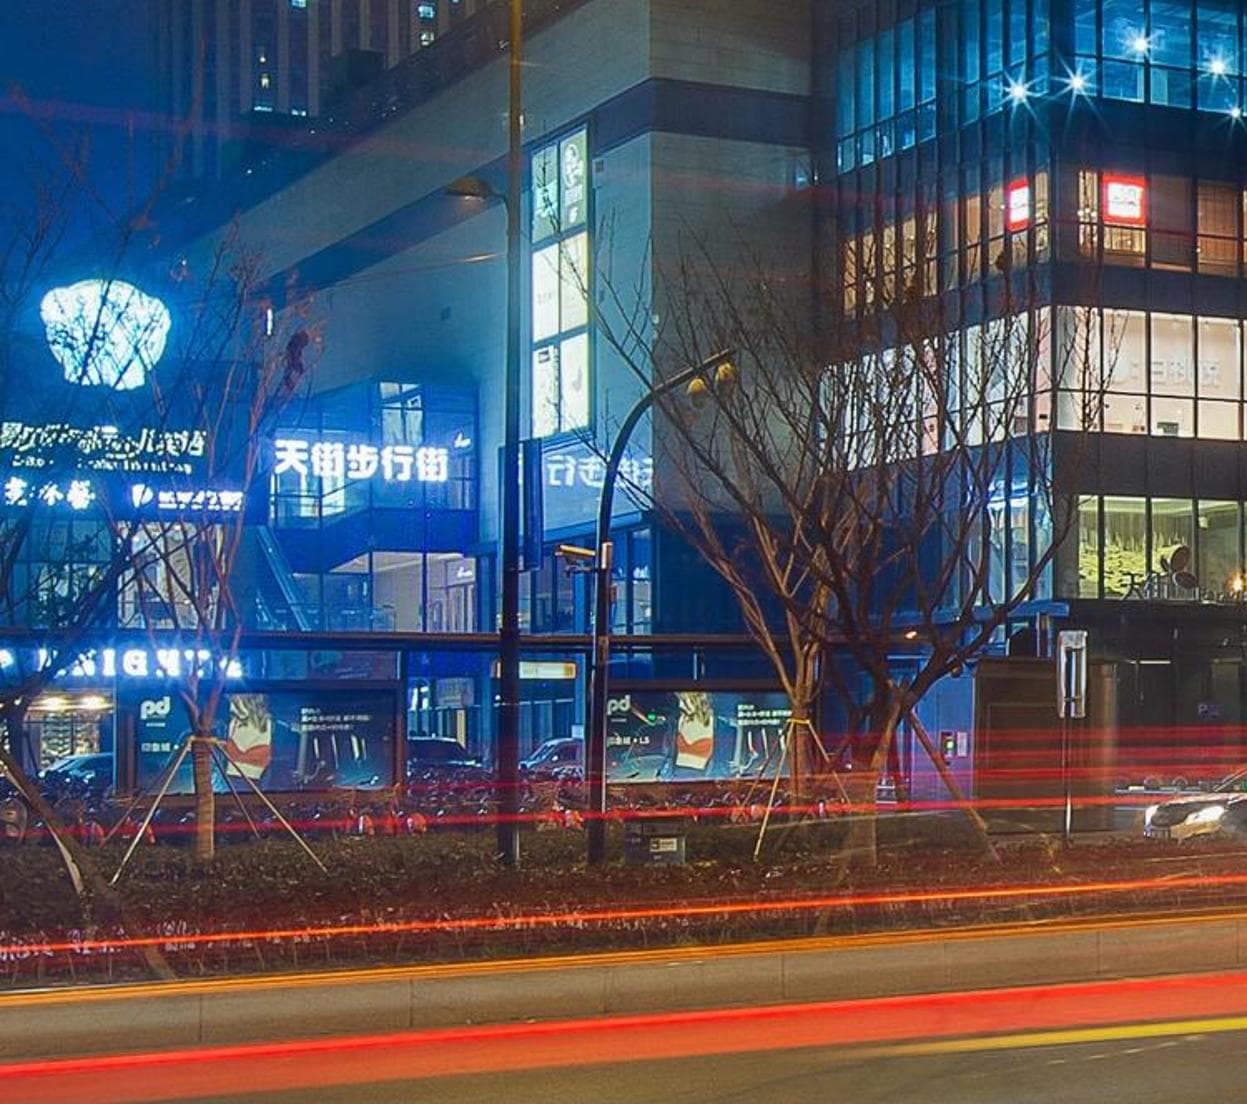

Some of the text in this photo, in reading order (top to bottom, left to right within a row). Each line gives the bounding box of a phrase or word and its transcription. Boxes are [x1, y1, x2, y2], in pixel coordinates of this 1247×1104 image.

[273, 438, 449, 483] 天街步行街
